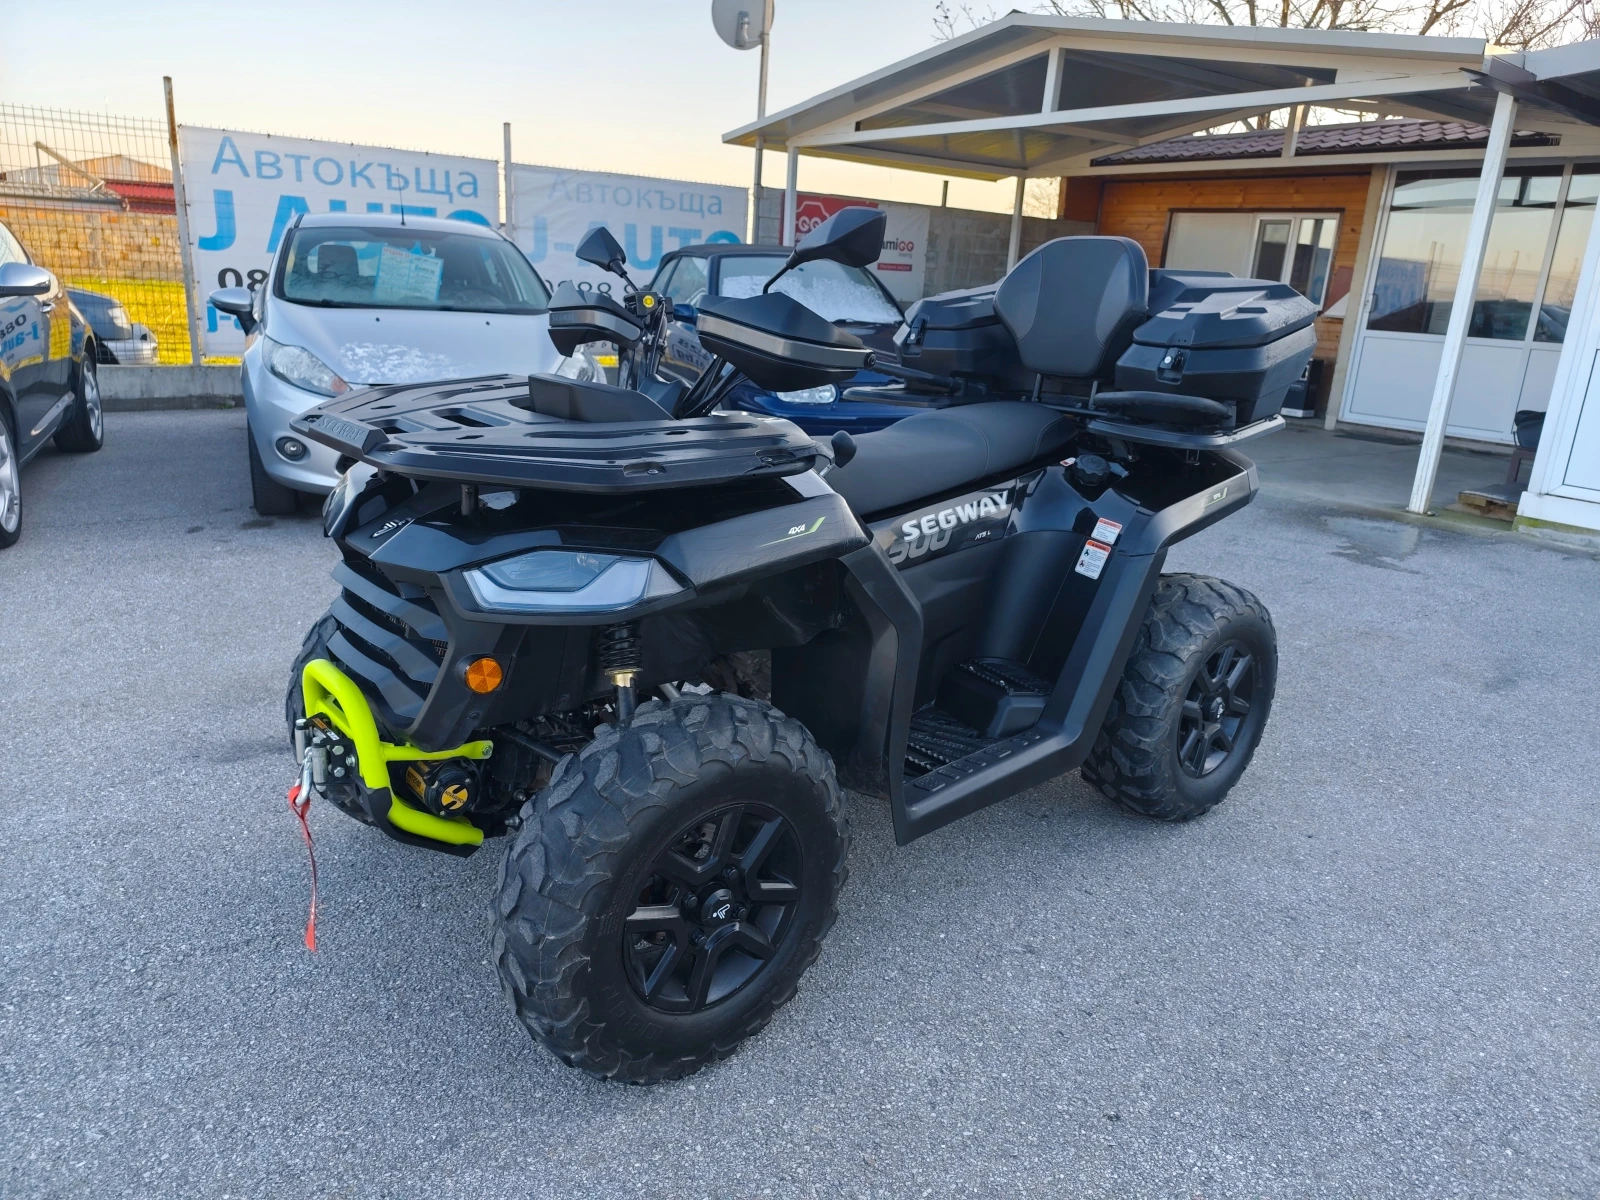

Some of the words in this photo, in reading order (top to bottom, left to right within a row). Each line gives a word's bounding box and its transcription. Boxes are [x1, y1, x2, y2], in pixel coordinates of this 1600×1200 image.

[211, 135, 480, 204] Автокъща
[548, 172, 723, 220] Автокъща
[320, 416, 365, 441] SEGWAY
[901, 489, 1009, 542] SEGWAY
